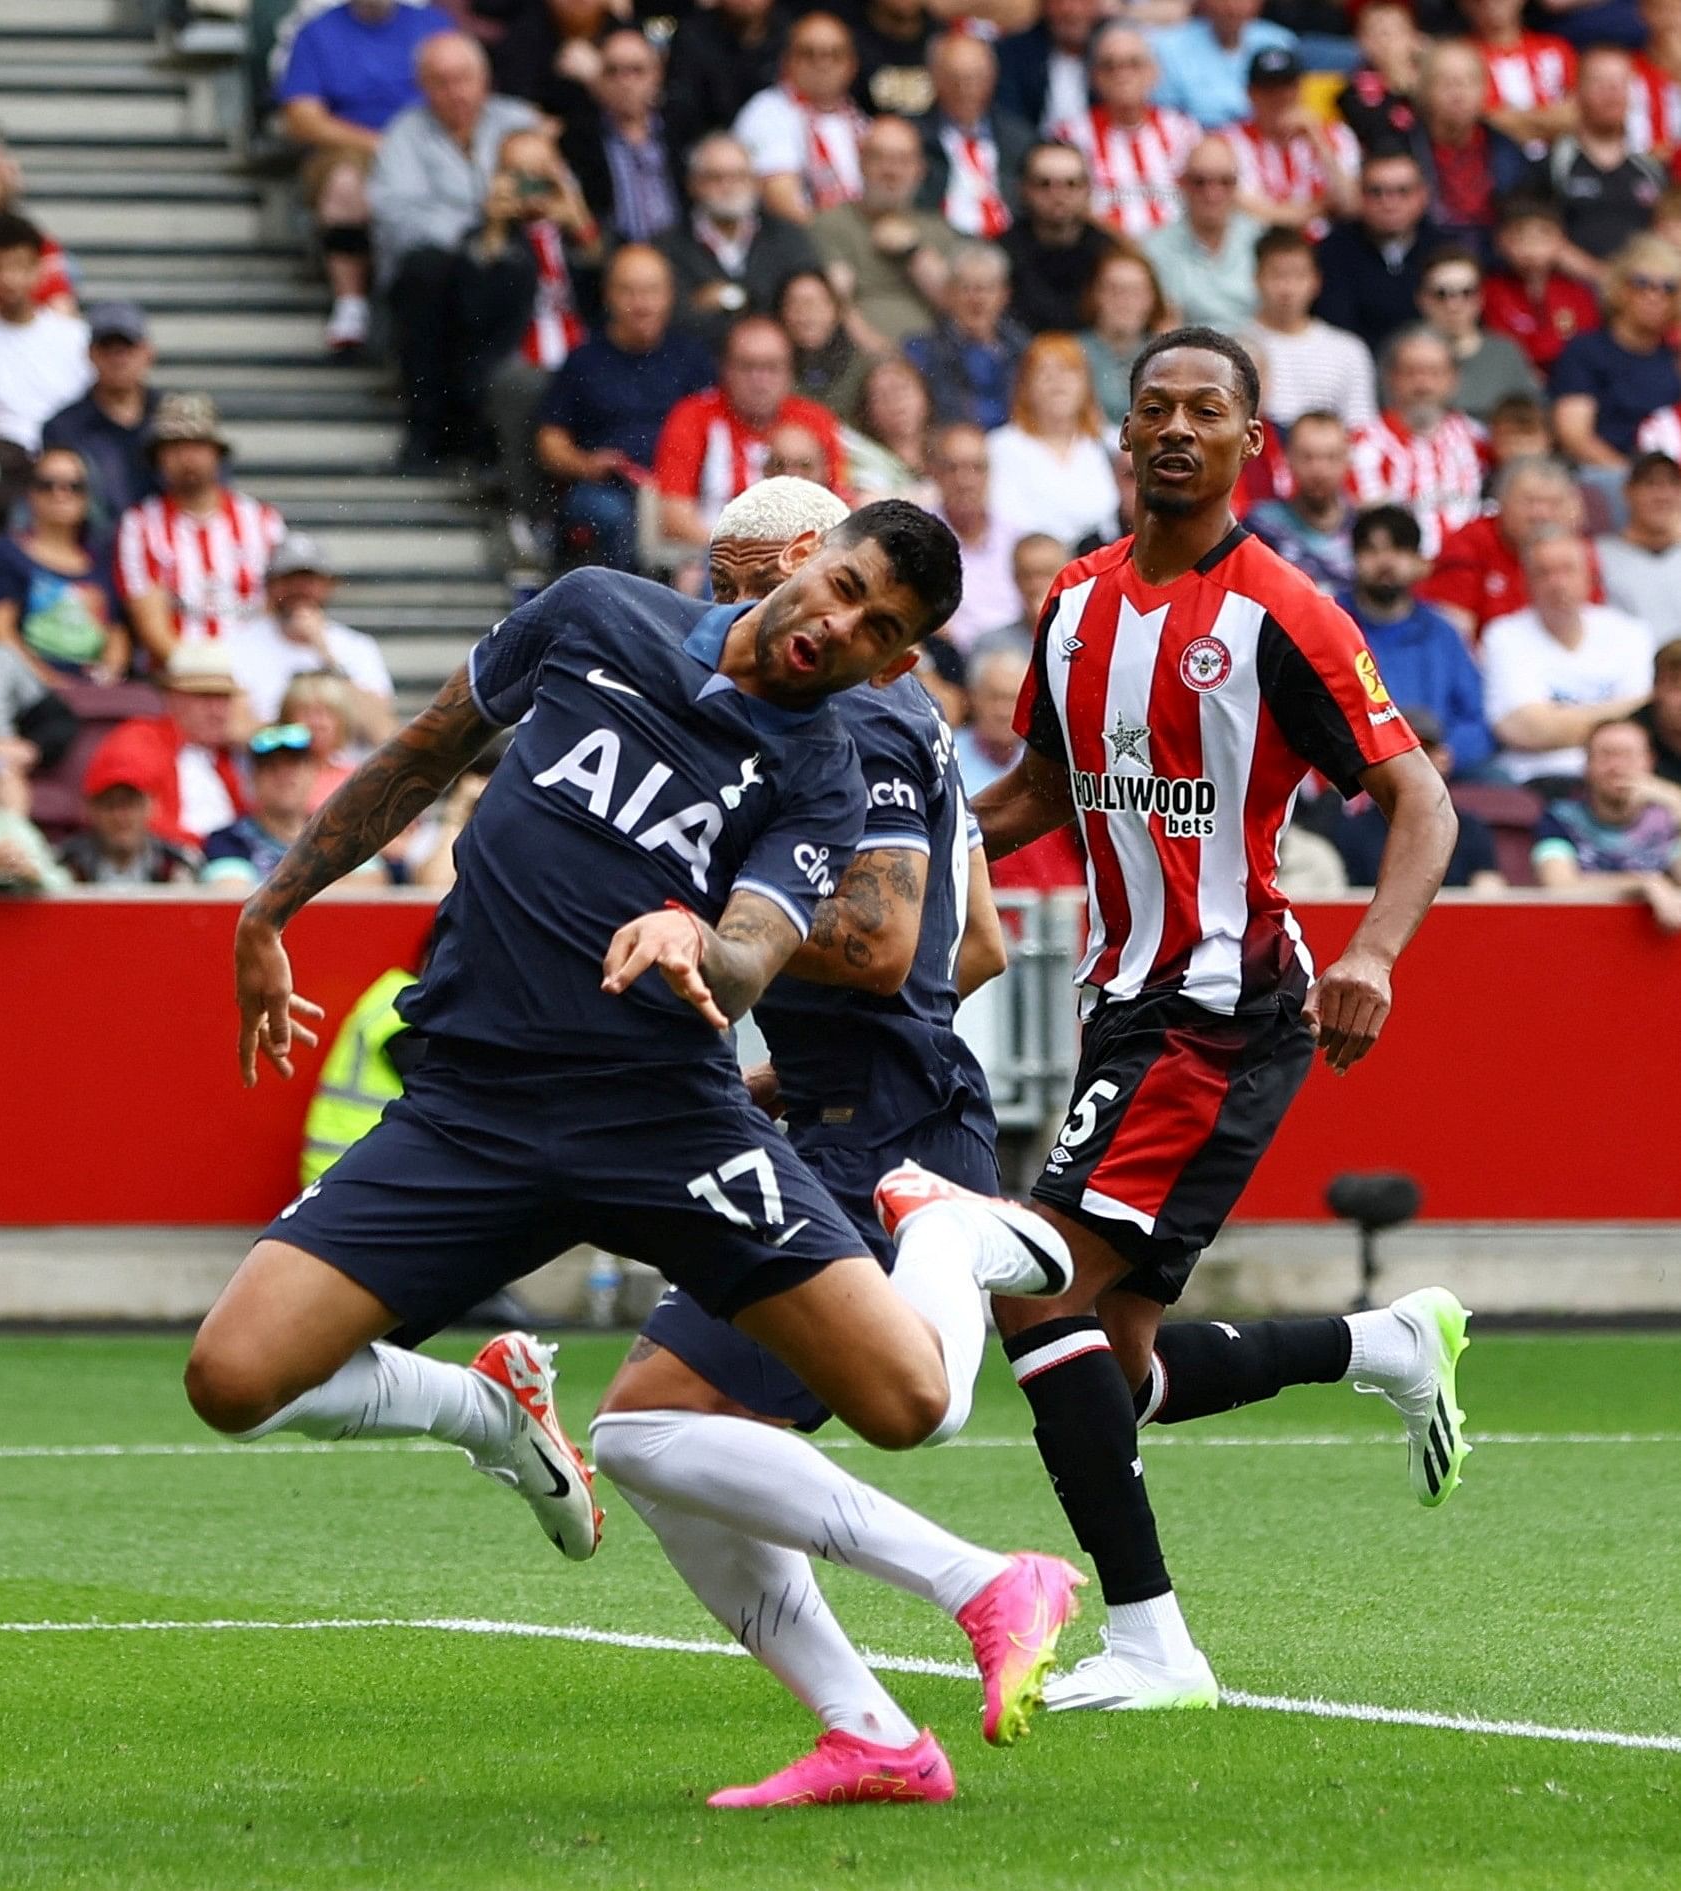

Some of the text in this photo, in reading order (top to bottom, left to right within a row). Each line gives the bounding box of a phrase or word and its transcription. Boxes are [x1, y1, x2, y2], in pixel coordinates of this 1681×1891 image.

[532, 728, 724, 895] AIA
[1072, 769, 1217, 816] HOLLYWOOD
[1167, 815, 1214, 835] bets
[1059, 1078, 1120, 1147] 5
[686, 1147, 785, 1231] 17
